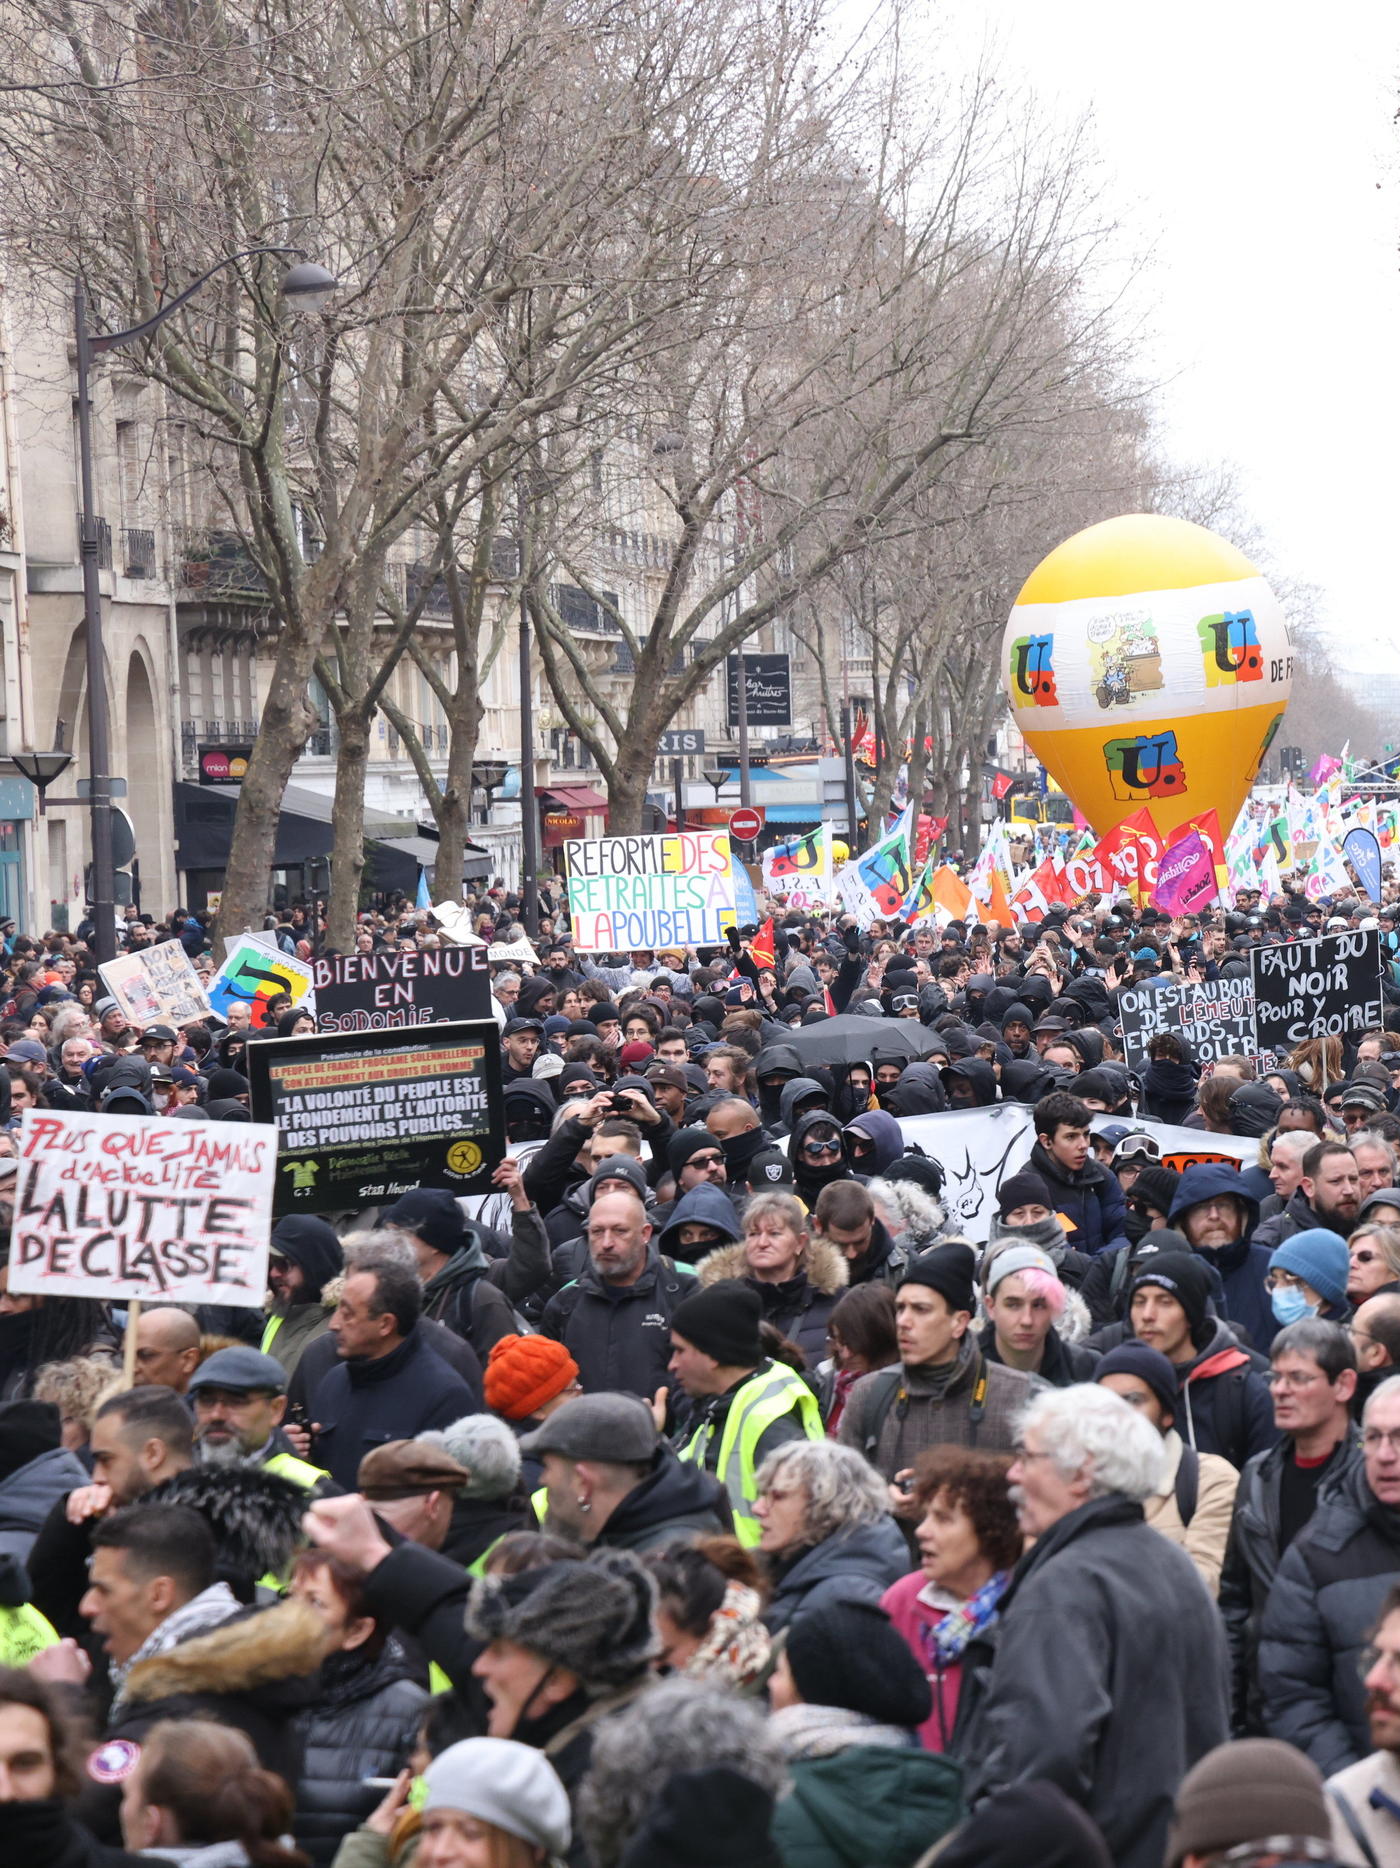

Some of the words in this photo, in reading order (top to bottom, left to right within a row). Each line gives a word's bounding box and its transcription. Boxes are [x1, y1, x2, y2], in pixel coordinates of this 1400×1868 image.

[567, 837, 678, 876] REFORME
[678, 834, 729, 875] DES
[574, 913, 613, 949] LA
[612, 907, 735, 949] POUBELLE
[489, 947, 532, 959] MONDE
[1260, 940, 1324, 978] FAUT
[1335, 931, 1369, 961] DU
[374, 979, 414, 1008] EN
[1121, 991, 1151, 1013] ON
[1156, 984, 1188, 1009] EST
[1190, 981, 1217, 1003] AU
[1219, 976, 1252, 998] BOR
[1139, 1006, 1172, 1029] DE
[1257, 998, 1304, 1025] POUR
[1313, 996, 1326, 1019] Y
[281, 1064, 313, 1077] PEUPLE
[314, 1063, 326, 1074] DE
[327, 1060, 361, 1073] FRANCE
[362, 1055, 410, 1070] PROCLAME
[410, 1047, 486, 1064] SOLENNELLEMENT
[320, 1049, 362, 1061] Préambule
[362, 1048, 373, 1057] de
[373, 1048, 383, 1056] la
[283, 1077, 304, 1090] SON
[304, 1070, 366, 1088] ATTACHEMENT
[367, 1068, 385, 1081] AUX
[387, 1065, 420, 1079] DROITS
[421, 1064, 432, 1075] DE
[433, 1060, 474, 1074] L'HOMME
[305, 1085, 372, 1109] VOLONTÉ
[374, 1086, 395, 1103] DU
[400, 1079, 452, 1100] PEUPLE
[453, 1076, 482, 1094] EST
[292, 1104, 382, 1128] FONDEMENT
[384, 1101, 404, 1119] DE
[23, 1118, 98, 1158] PLUS
[101, 1127, 175, 1160] QUE
[287, 1130, 318, 1149] DES
[80, 1231, 256, 1293] CLASSE
